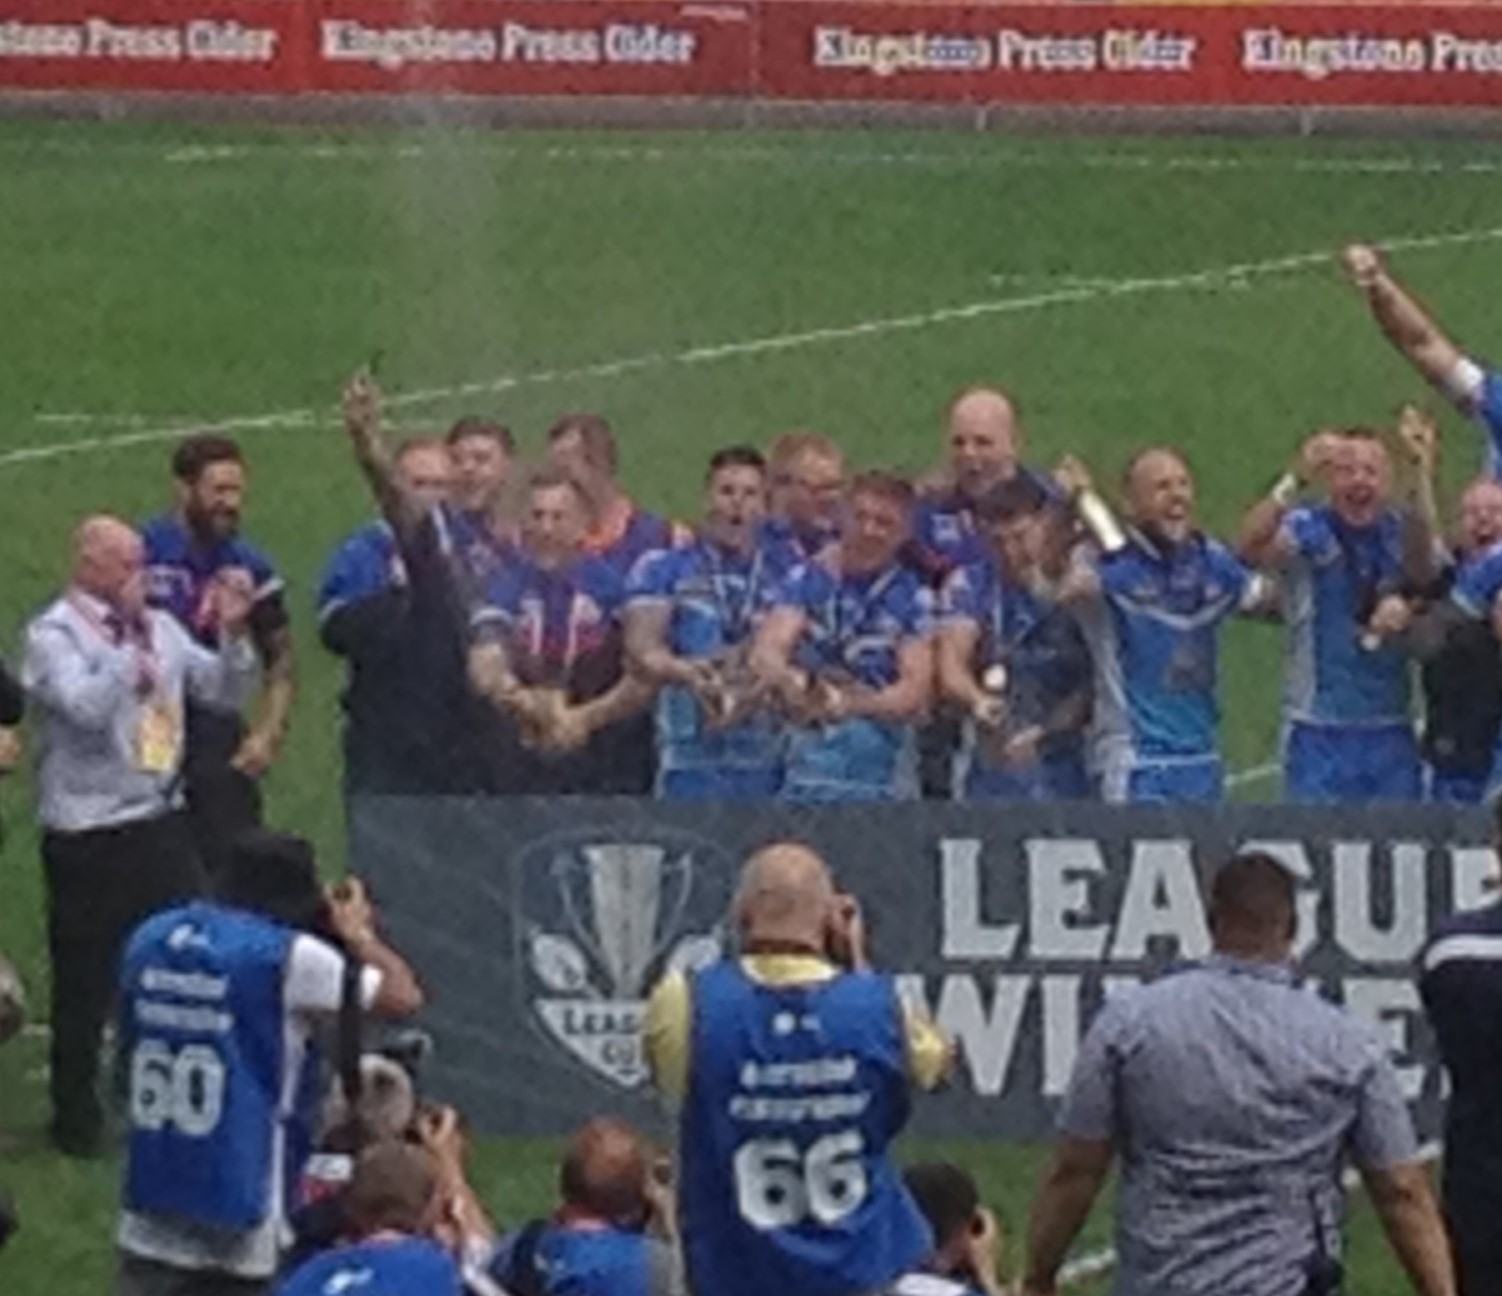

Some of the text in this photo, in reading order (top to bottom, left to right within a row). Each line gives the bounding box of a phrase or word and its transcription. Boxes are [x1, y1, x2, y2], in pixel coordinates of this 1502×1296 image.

[86, 18, 182, 59] Press
[185, 20, 278, 60] Cider
[321, 20, 696, 68] Kingstone Press Cider
[815, 26, 1196, 75] Kingstone Press Cider
[1242, 28, 1425, 79] Kingstone
[130, 1038, 225, 1136] 60
[734, 1128, 867, 1233] 66
